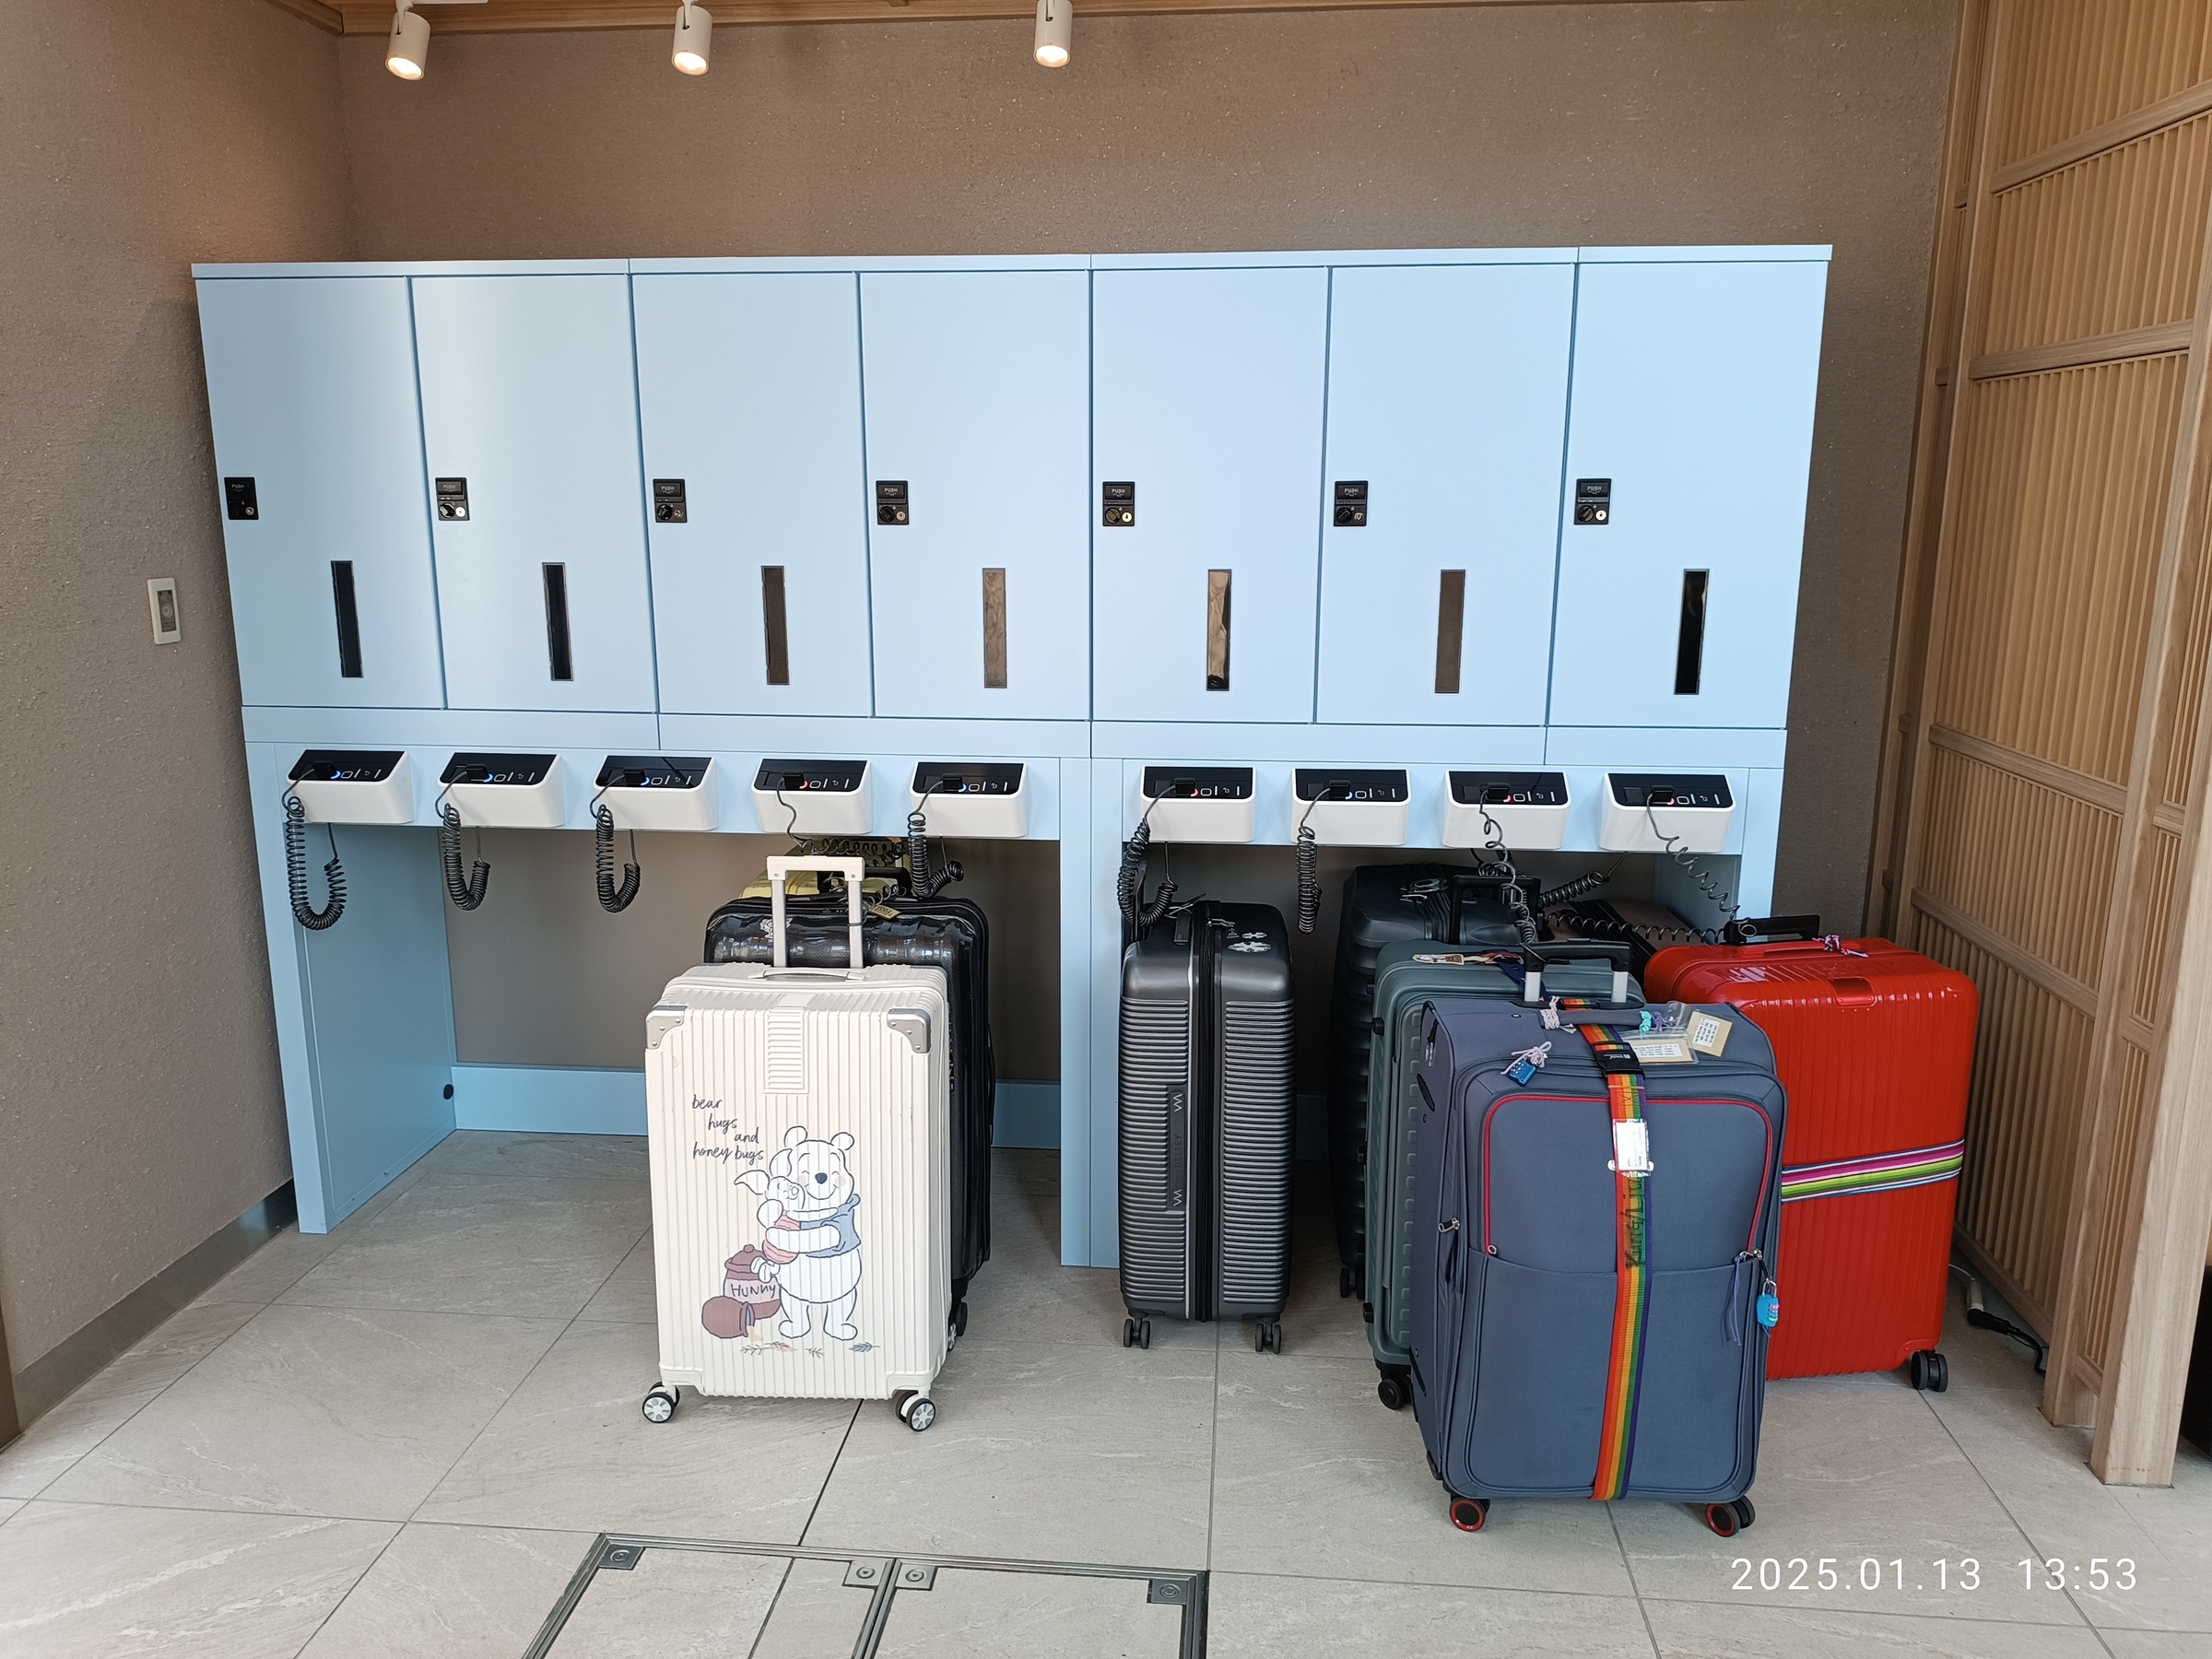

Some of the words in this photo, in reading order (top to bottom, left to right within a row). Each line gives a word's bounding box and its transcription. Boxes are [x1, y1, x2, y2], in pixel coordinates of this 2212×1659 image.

[692, 1094, 723, 1110] bear
[708, 1112, 737, 1135] hugs
[734, 1127, 759, 1144] and
[692, 1142, 734, 1165] honey
[734, 1146, 764, 1165] bugs
